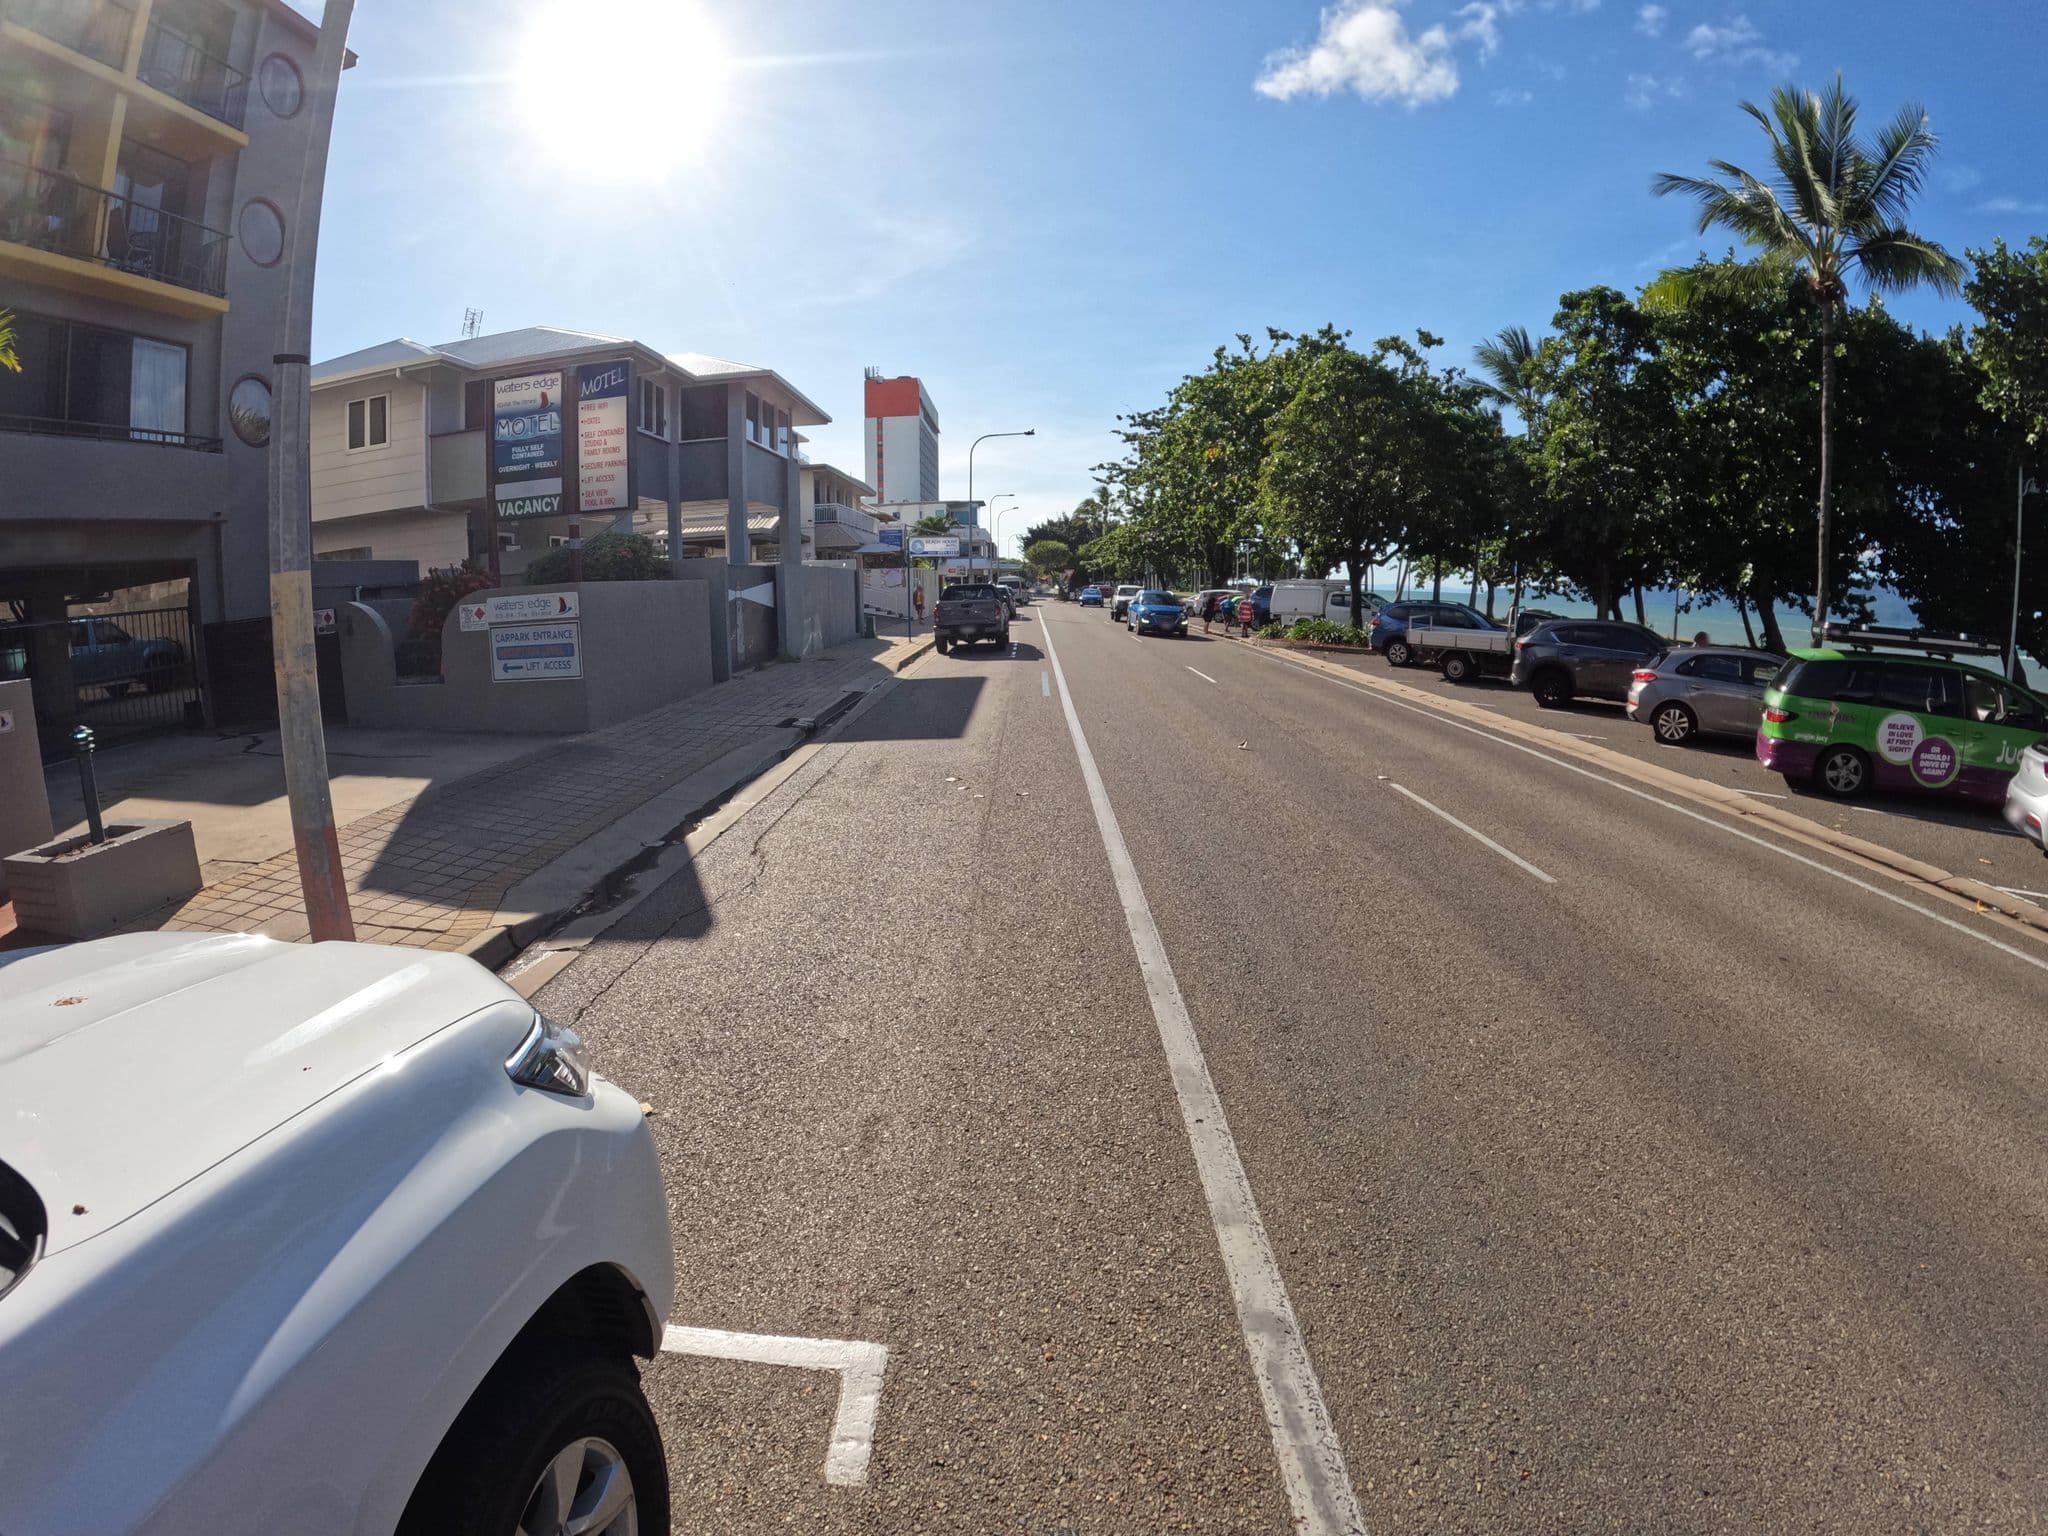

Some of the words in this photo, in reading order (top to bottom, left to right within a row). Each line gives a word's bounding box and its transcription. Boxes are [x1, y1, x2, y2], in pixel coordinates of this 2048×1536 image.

[496, 381, 530, 394] waters
[533, 377, 559, 390] edge
[581, 367, 625, 397] MOTEL
[497, 413, 558, 438] MOTEL
[511, 445, 529, 453] FULLY
[530, 443, 544, 451] SELF
[511, 450, 544, 460] CONTAINED
[498, 463, 530, 473] OVERNIGHT
[534, 460, 558, 469] WEEKLY
[497, 496, 560, 517] VACANCY
[495, 599, 524, 611] waters
[528, 597, 551, 610] edge
[495, 632, 530, 643] CARPARK
[533, 629, 573, 641] ENTRANCE
[525, 661, 540, 671] LIFT
[543, 660, 572, 671] ACCESS
[1888, 723, 1914, 731] BELIEVE
[1888, 745, 1911, 753] SIGHT?
[1920, 752, 1947, 761] SHOULD
[1920, 760, 1940, 768] DRIVE
[1941, 761, 1950, 769] BY
[1922, 767, 1946, 776] AGAIN?
